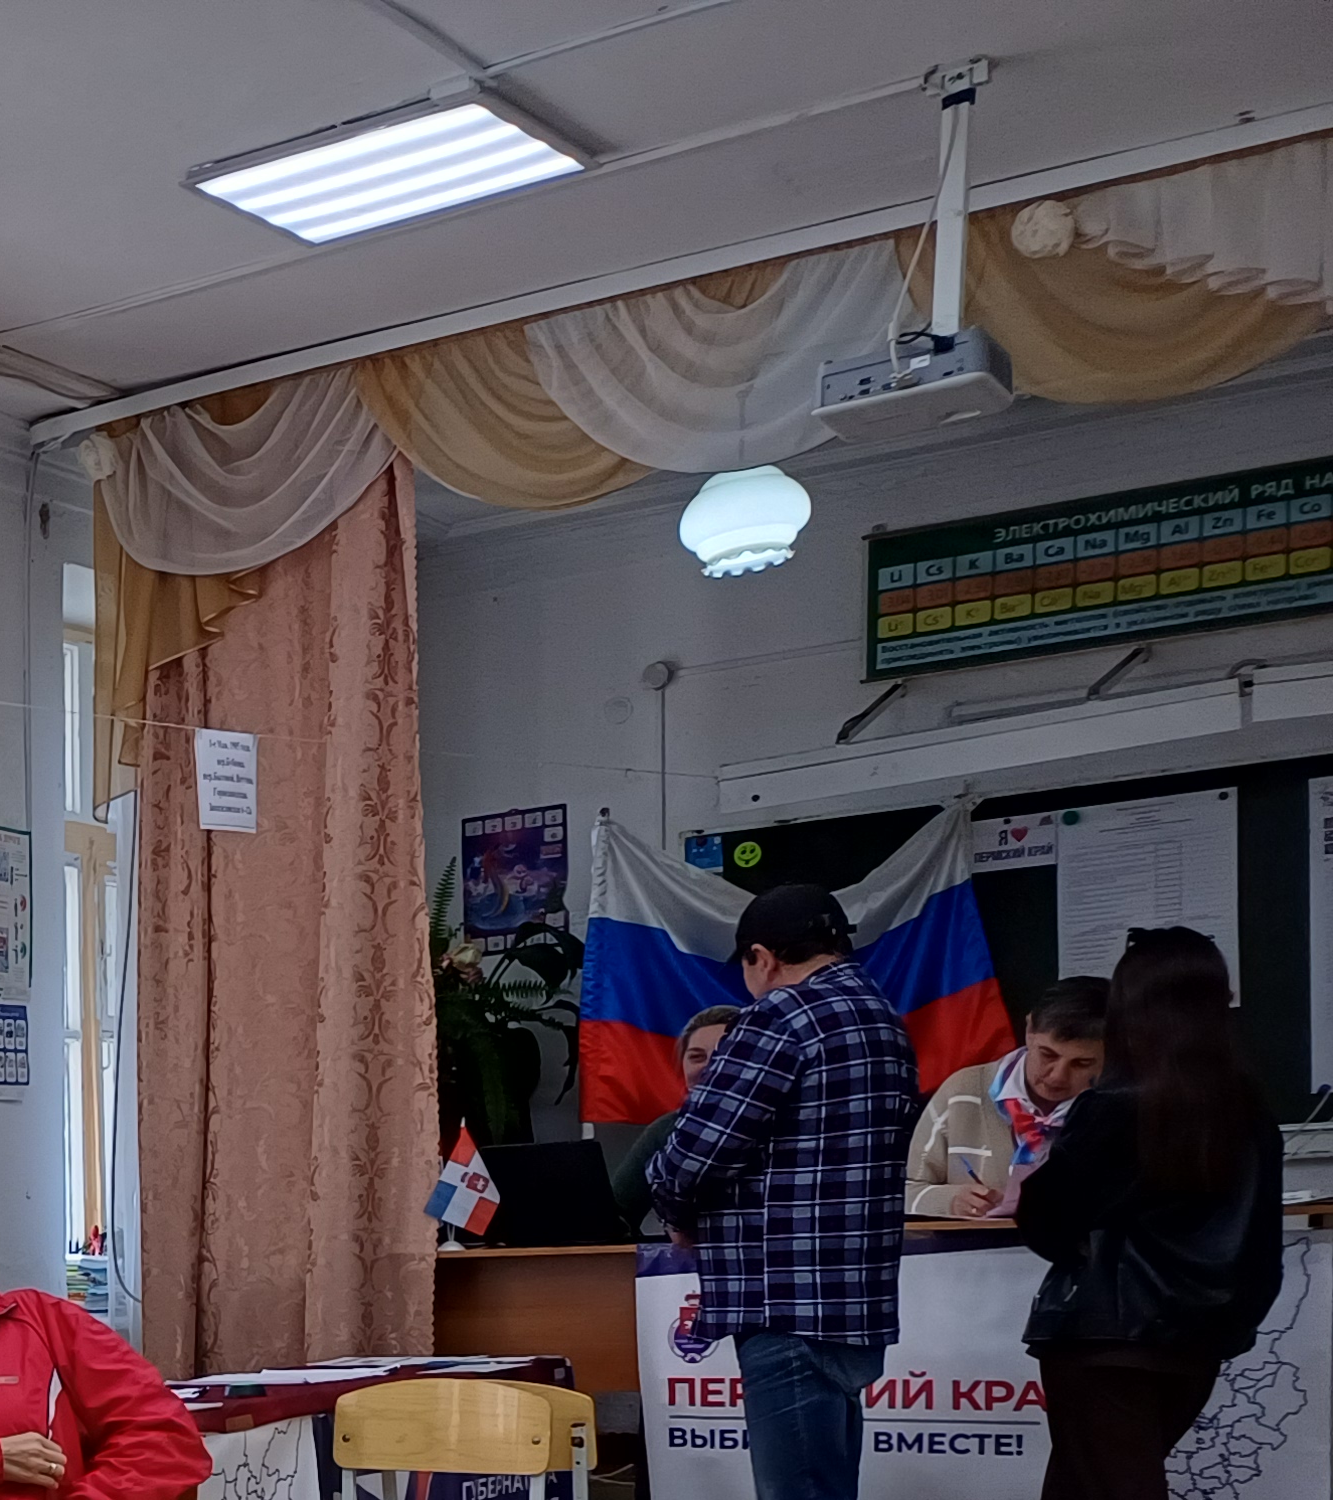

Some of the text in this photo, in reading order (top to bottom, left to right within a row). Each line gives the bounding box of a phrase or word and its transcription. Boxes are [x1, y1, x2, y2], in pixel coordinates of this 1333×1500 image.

[993, 485, 1239, 543] ЭЛЕКТРОХИМИЧЕСКИЙ
[1251, 479, 1295, 498] РЯД
[926, 564, 944, 577] Cs
[968, 558, 980, 571] K
[1004, 552, 1025, 564] Ba
[1044, 544, 1065, 557] Ca
[1084, 537, 1107, 551] Na
[1124, 529, 1150, 545] Mg
[1171, 521, 1190, 536] Al
[1212, 516, 1234, 529] Zn
[1256, 508, 1277, 522] Fe
[1299, 502, 1322, 515] Co
[998, 829, 1009, 847] Я
[952, 1378, 1048, 1412] КРА
[873, 1431, 1024, 1457] ВМЕСТЕ!
